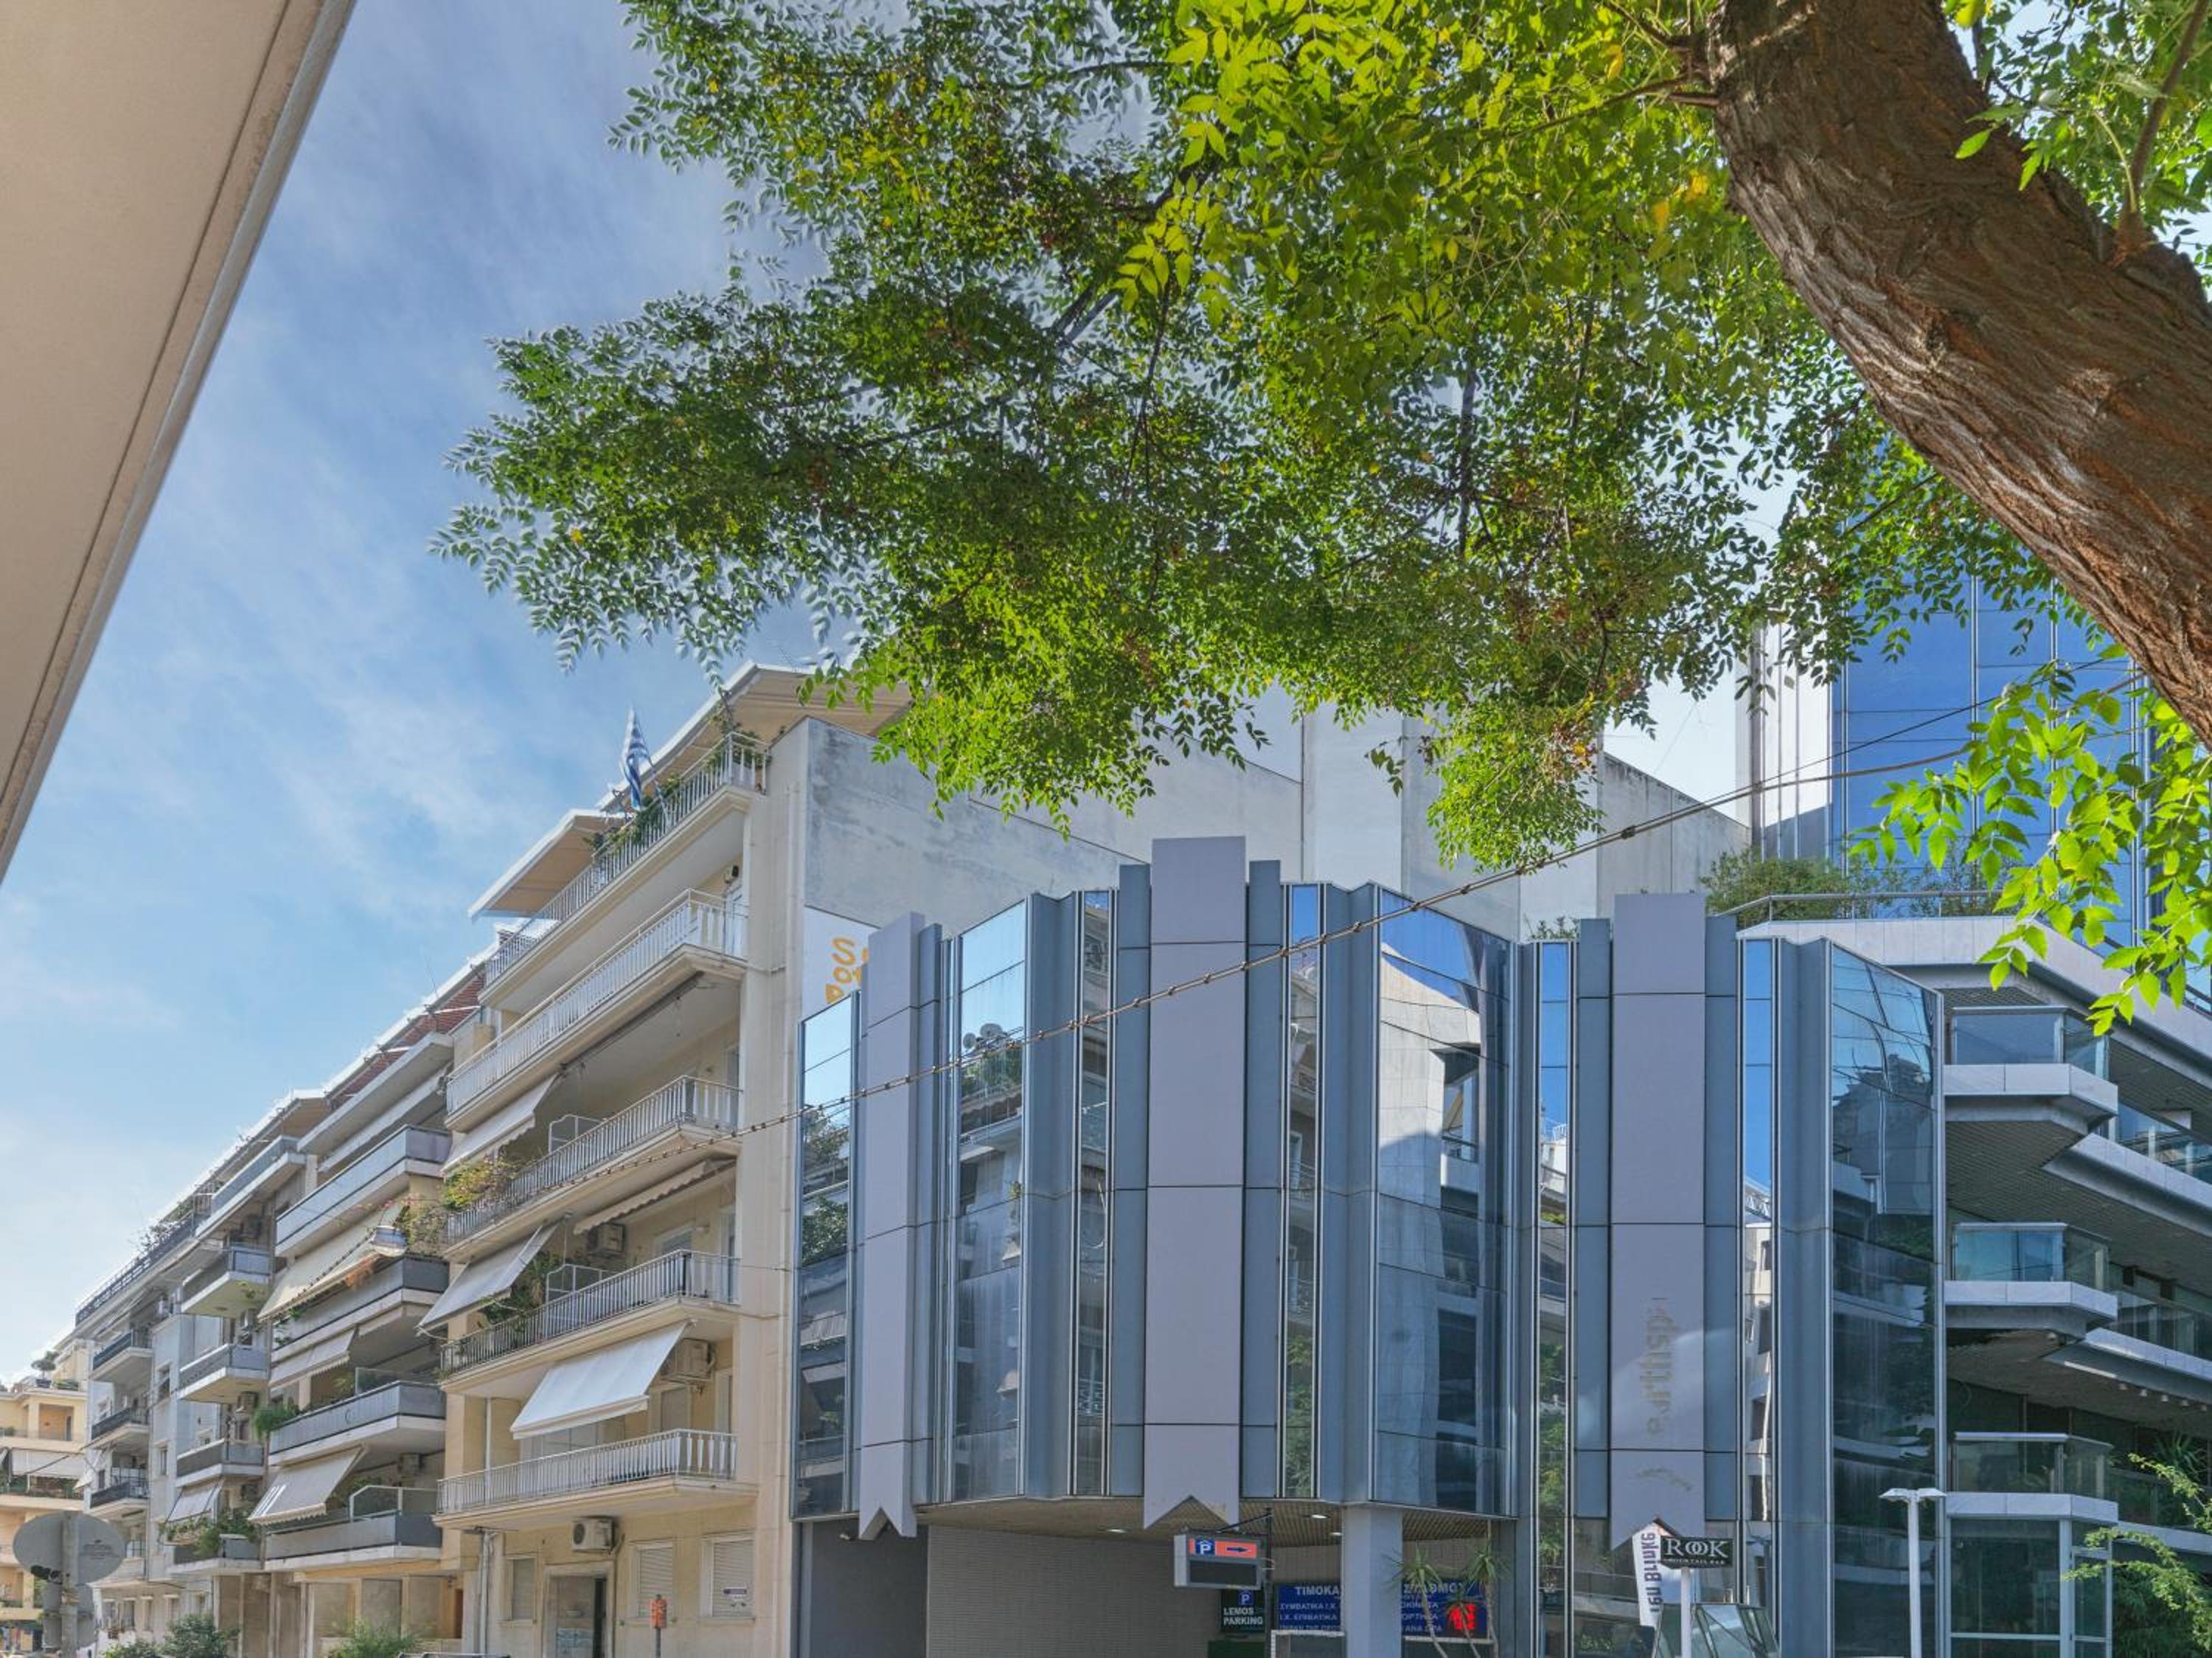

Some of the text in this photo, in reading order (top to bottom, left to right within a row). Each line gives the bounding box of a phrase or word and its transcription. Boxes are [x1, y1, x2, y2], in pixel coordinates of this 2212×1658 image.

[1664, 1539, 1729, 1558] ROOK
[1223, 1607, 1254, 1616] LEMOS
[1223, 1616, 1263, 1626] PARKING
